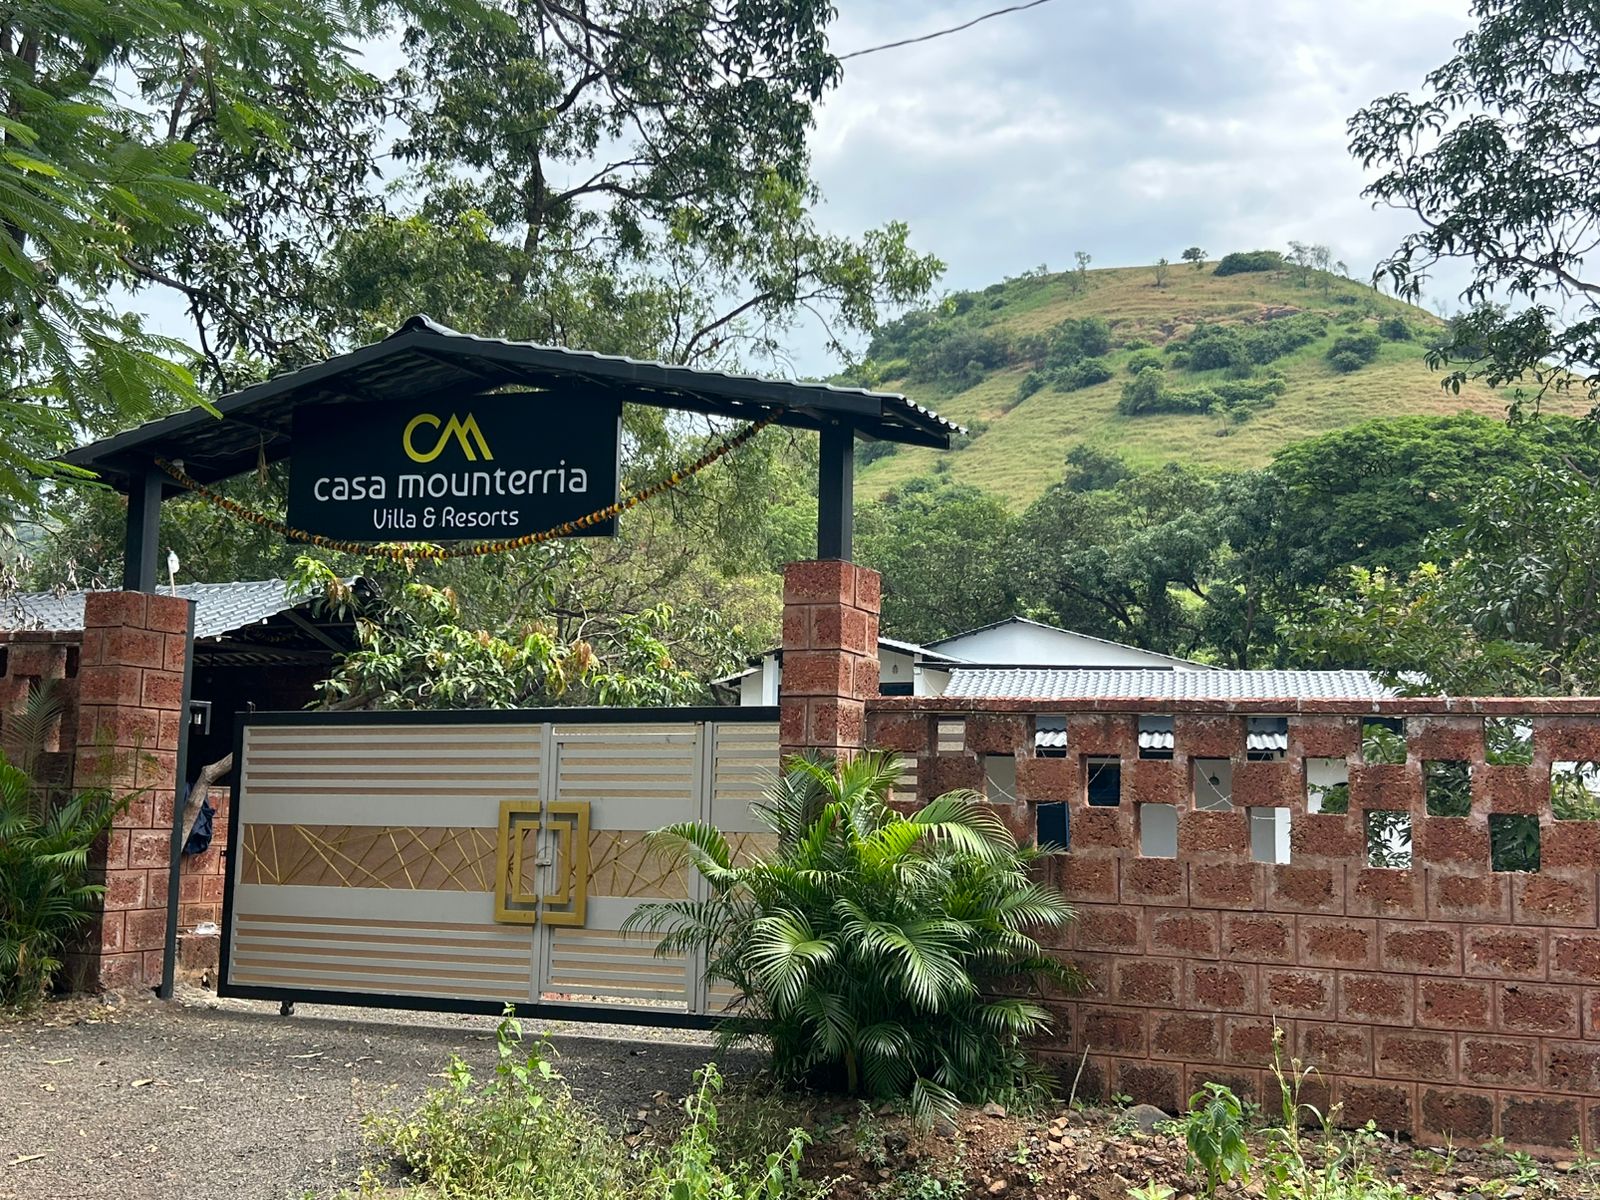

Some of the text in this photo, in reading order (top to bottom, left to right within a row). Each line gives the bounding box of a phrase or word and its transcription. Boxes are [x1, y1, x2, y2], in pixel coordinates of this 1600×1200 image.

[314, 459, 588, 502] casa mounterria
[373, 506, 519, 529] Villa & Resorts
